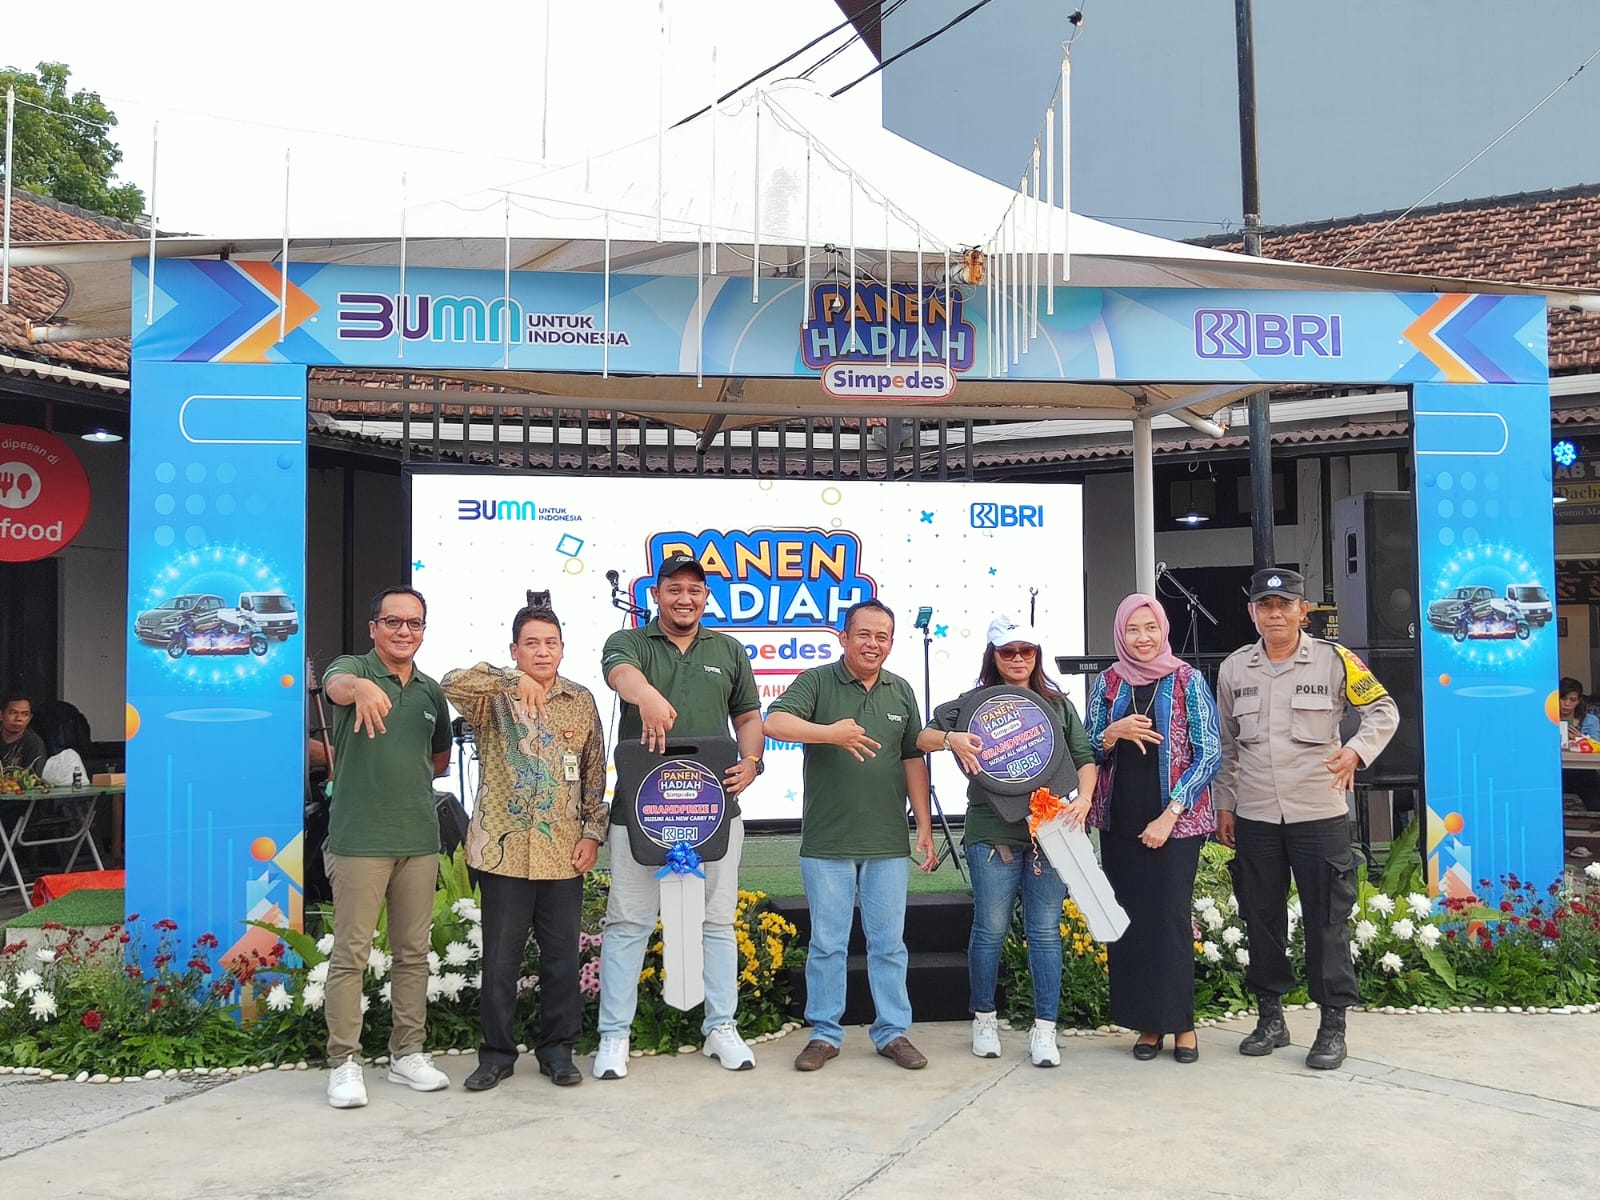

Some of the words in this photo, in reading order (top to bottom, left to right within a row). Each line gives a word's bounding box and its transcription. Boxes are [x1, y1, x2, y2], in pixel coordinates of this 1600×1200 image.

[822, 292, 953, 324] PANEN
[528, 314, 593, 329] UNTUK
[528, 330, 629, 346] INDONESIA
[811, 326, 966, 361] HADIAH
[1255, 314, 1342, 357] BRI
[833, 370, 945, 392] Simpedes
[1, 439, 47, 457] dipesan
[47, 454, 61, 465] di
[538, 514, 583, 522] INDONESIA
[1000, 504, 1044, 527] BRI
[1296, 685, 1328, 695] POLRI
[982, 702, 1014, 723] PANEN
[984, 710, 1021, 733] HADIAH
[1020, 753, 1041, 769] BRI
[663, 771, 699, 780] PANEN
[660, 780, 701, 790] HADIAH
[677, 828, 697, 840] BRI
